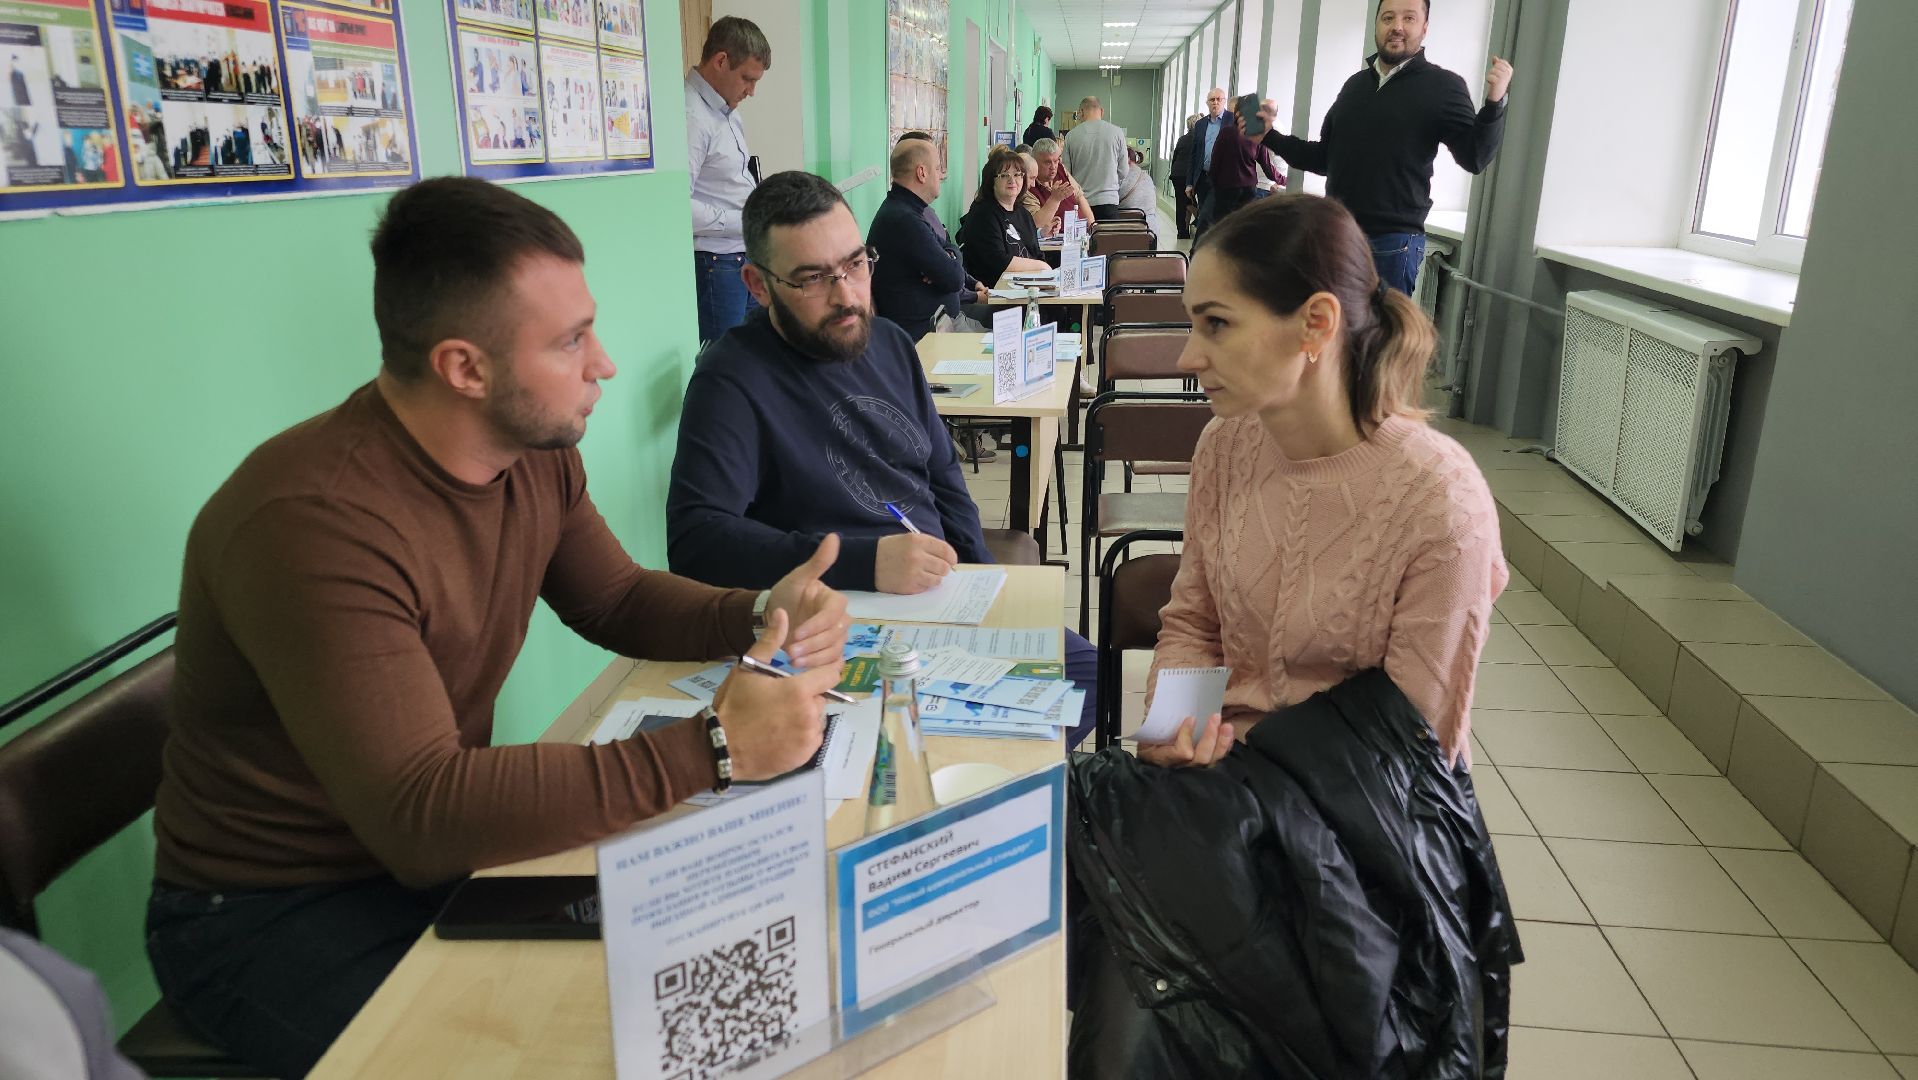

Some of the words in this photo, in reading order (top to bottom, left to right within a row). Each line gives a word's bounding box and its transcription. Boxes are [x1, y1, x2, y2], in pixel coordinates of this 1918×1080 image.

[616, 851, 649, 870] НАМ
[653, 831, 704, 856] ВАЖНО
[707, 817, 743, 837] ВАШЕ
[749, 794, 806, 822] МНЕНИЕ!
[868, 830, 953, 876] СТЕФАНСКИЙ
[868, 865, 911, 892] Вадим
[915, 839, 979, 872] Сергеевич
[867, 902, 889, 918] ООО
[869, 919, 933, 955] Генеральный
[935, 900, 980, 925] директор
